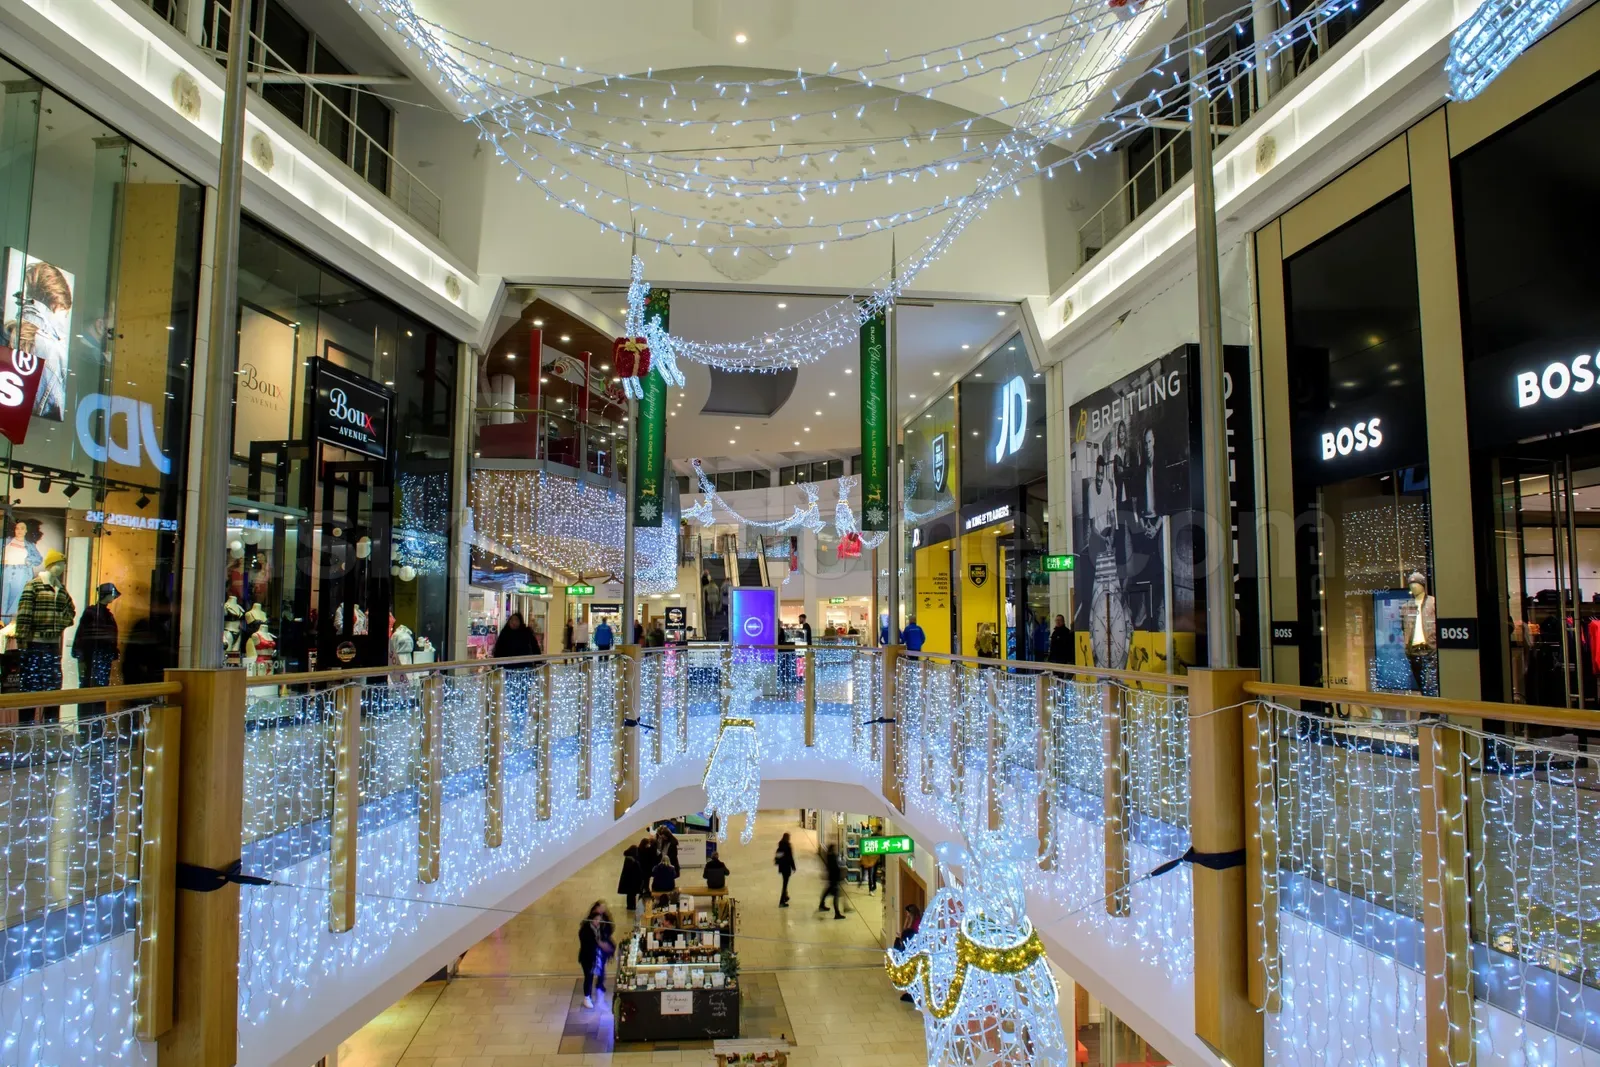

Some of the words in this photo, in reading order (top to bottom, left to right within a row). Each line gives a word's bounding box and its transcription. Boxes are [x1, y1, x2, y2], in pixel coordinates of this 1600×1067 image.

[242, 362, 286, 403] Boux
[867, 344, 882, 390] Christmas
[1517, 351, 1600, 408] BOS
[250, 396, 279, 411] AVENUE
[329, 387, 376, 436] Boux
[643, 382, 661, 421] shopping
[866, 391, 881, 427] shopping
[996, 374, 1028, 464] JD
[1091, 370, 1181, 432] BREITLING
[338, 425, 368, 443] AVENUE
[1321, 417, 1383, 461] BOSS
[1274, 628, 1293, 638] BOSS
[1441, 627, 1469, 640] BOSS
[1335, 677, 1348, 685] LIKE
